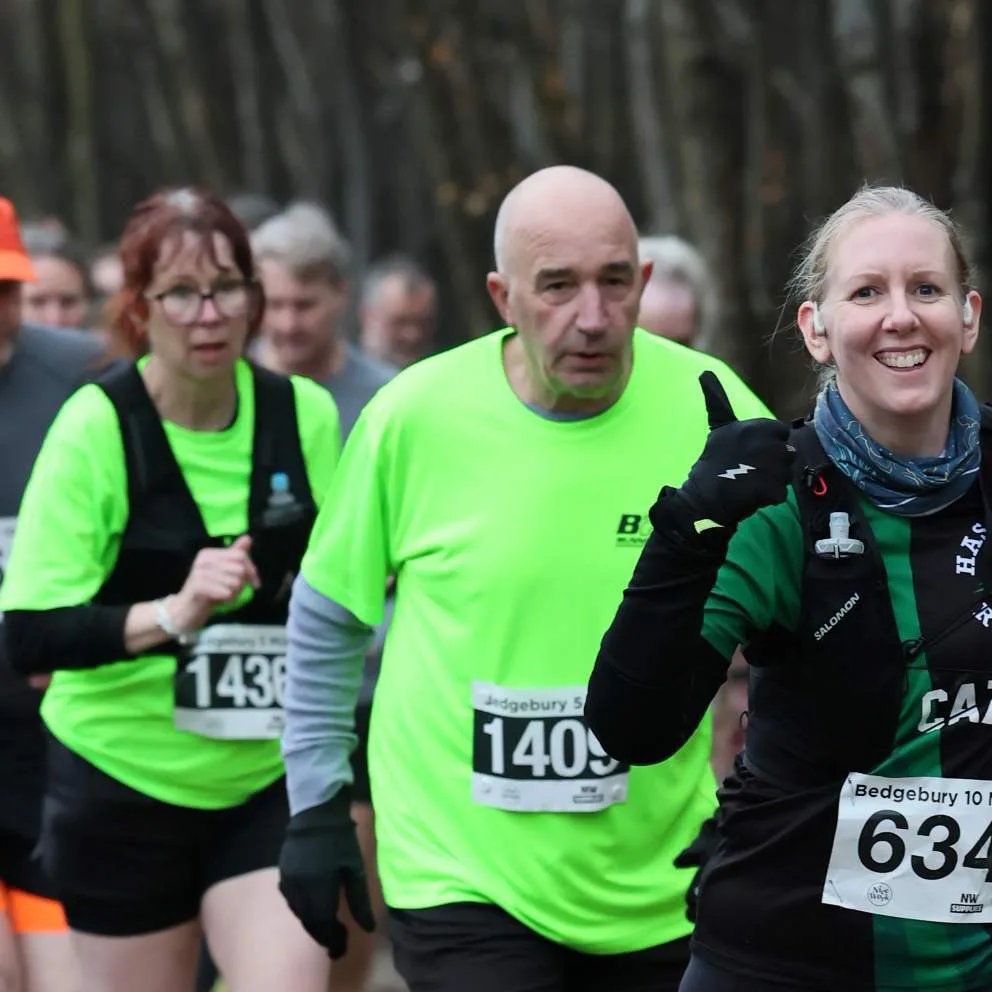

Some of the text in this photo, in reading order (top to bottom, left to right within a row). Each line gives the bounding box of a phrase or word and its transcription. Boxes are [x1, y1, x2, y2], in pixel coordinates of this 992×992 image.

[813, 592, 861, 641] SALOMON
[483, 717, 620, 778] 1409
[855, 784, 958, 807] Bedgebury
[965, 790, 982, 805] 10
[960, 893, 979, 904] NW
